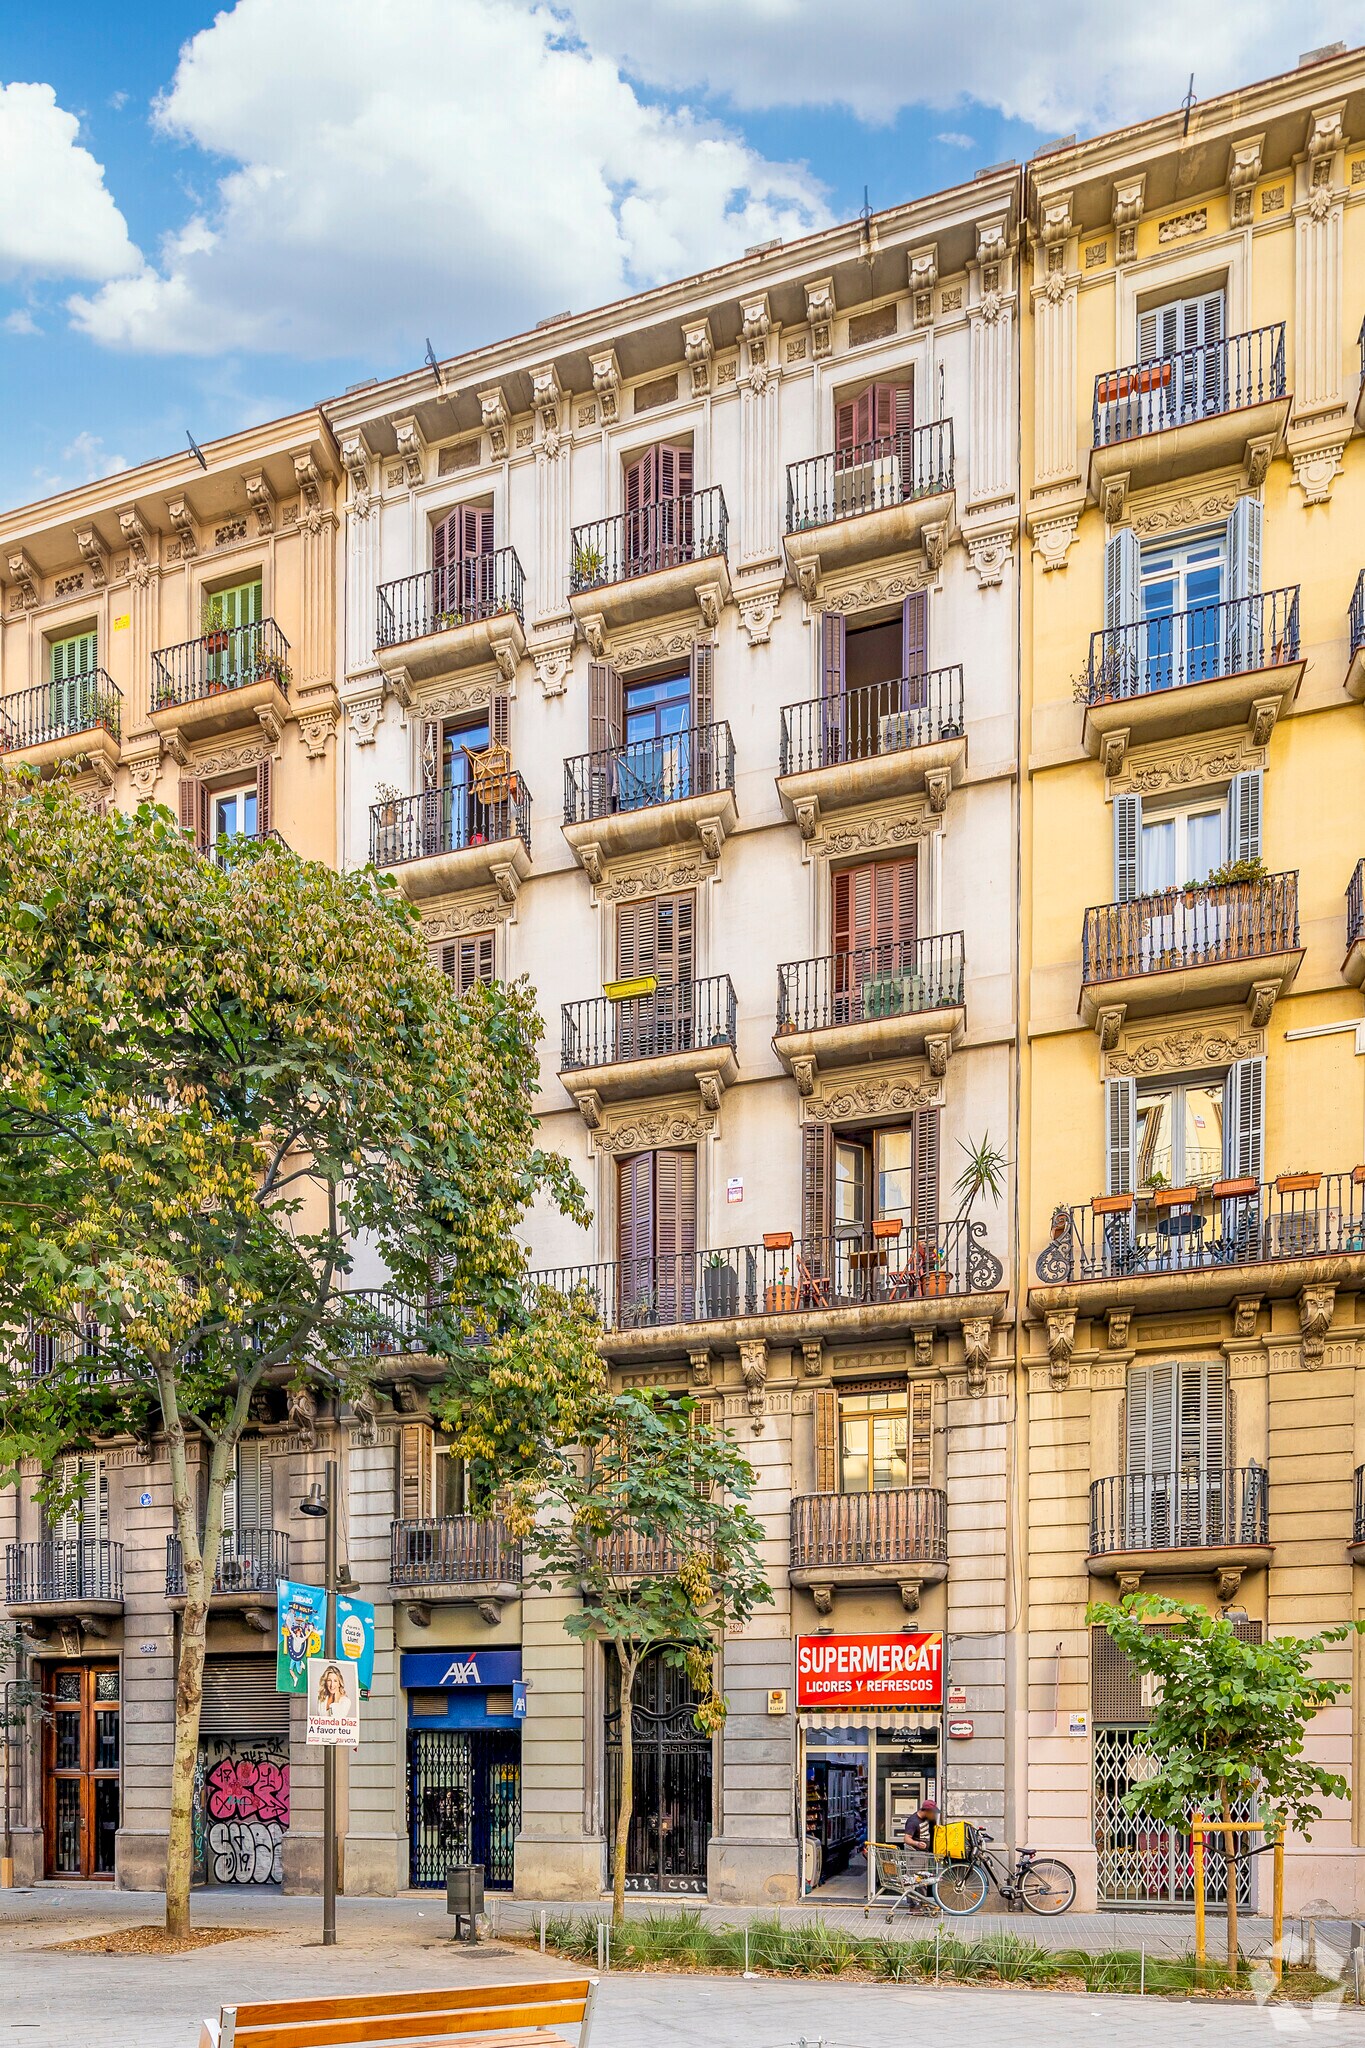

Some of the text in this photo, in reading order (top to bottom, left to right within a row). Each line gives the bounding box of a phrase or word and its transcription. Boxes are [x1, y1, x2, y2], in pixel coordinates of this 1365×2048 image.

[799, 1644, 941, 1674] SUPERMERCAT
[439, 1662, 481, 1685] AXA
[806, 1679, 933, 1693] LICORES Y REFRESCOS
[308, 1717, 357, 1727] Yolanda Díaz
[308, 1726, 351, 1735] A favor teu
